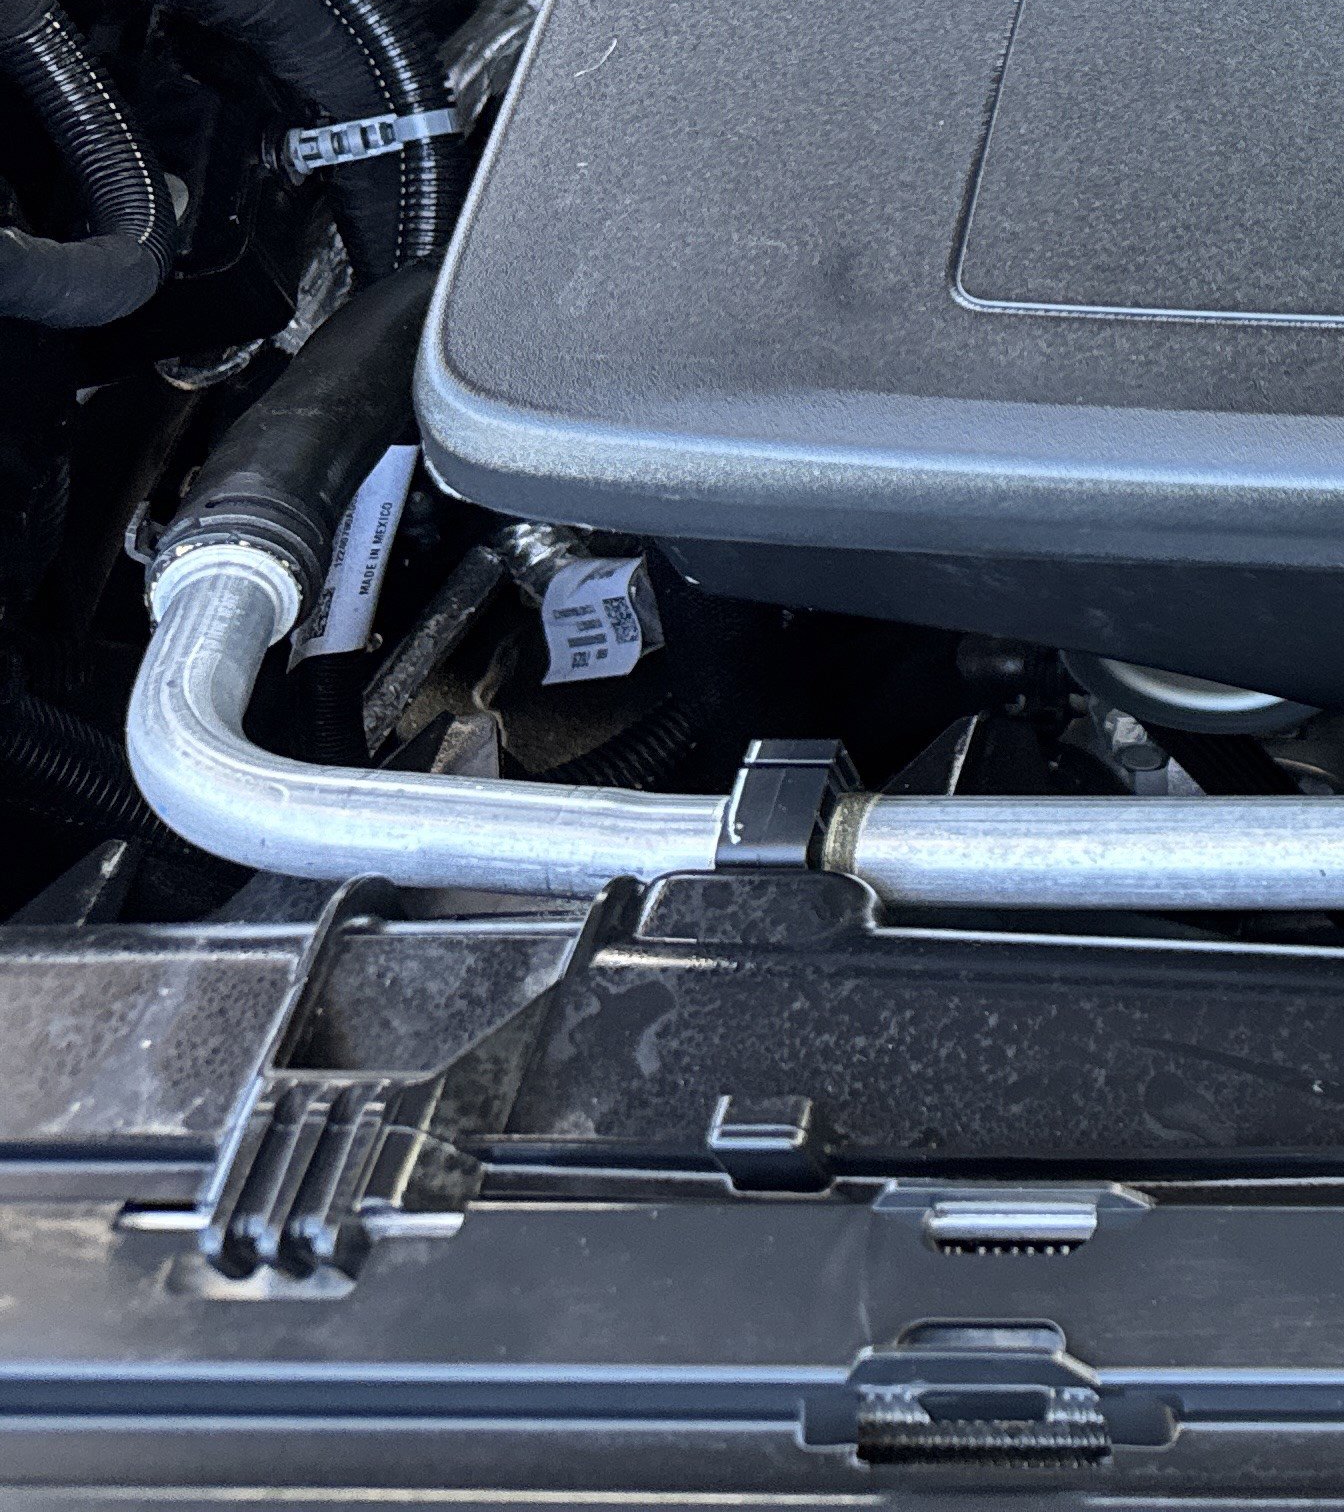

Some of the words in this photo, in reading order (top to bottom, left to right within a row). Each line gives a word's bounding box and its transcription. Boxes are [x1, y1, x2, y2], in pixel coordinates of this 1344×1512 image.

[373, 502, 393, 544] MEXICO
[369, 548, 381, 561] IN
[359, 564, 377, 595] MADE
